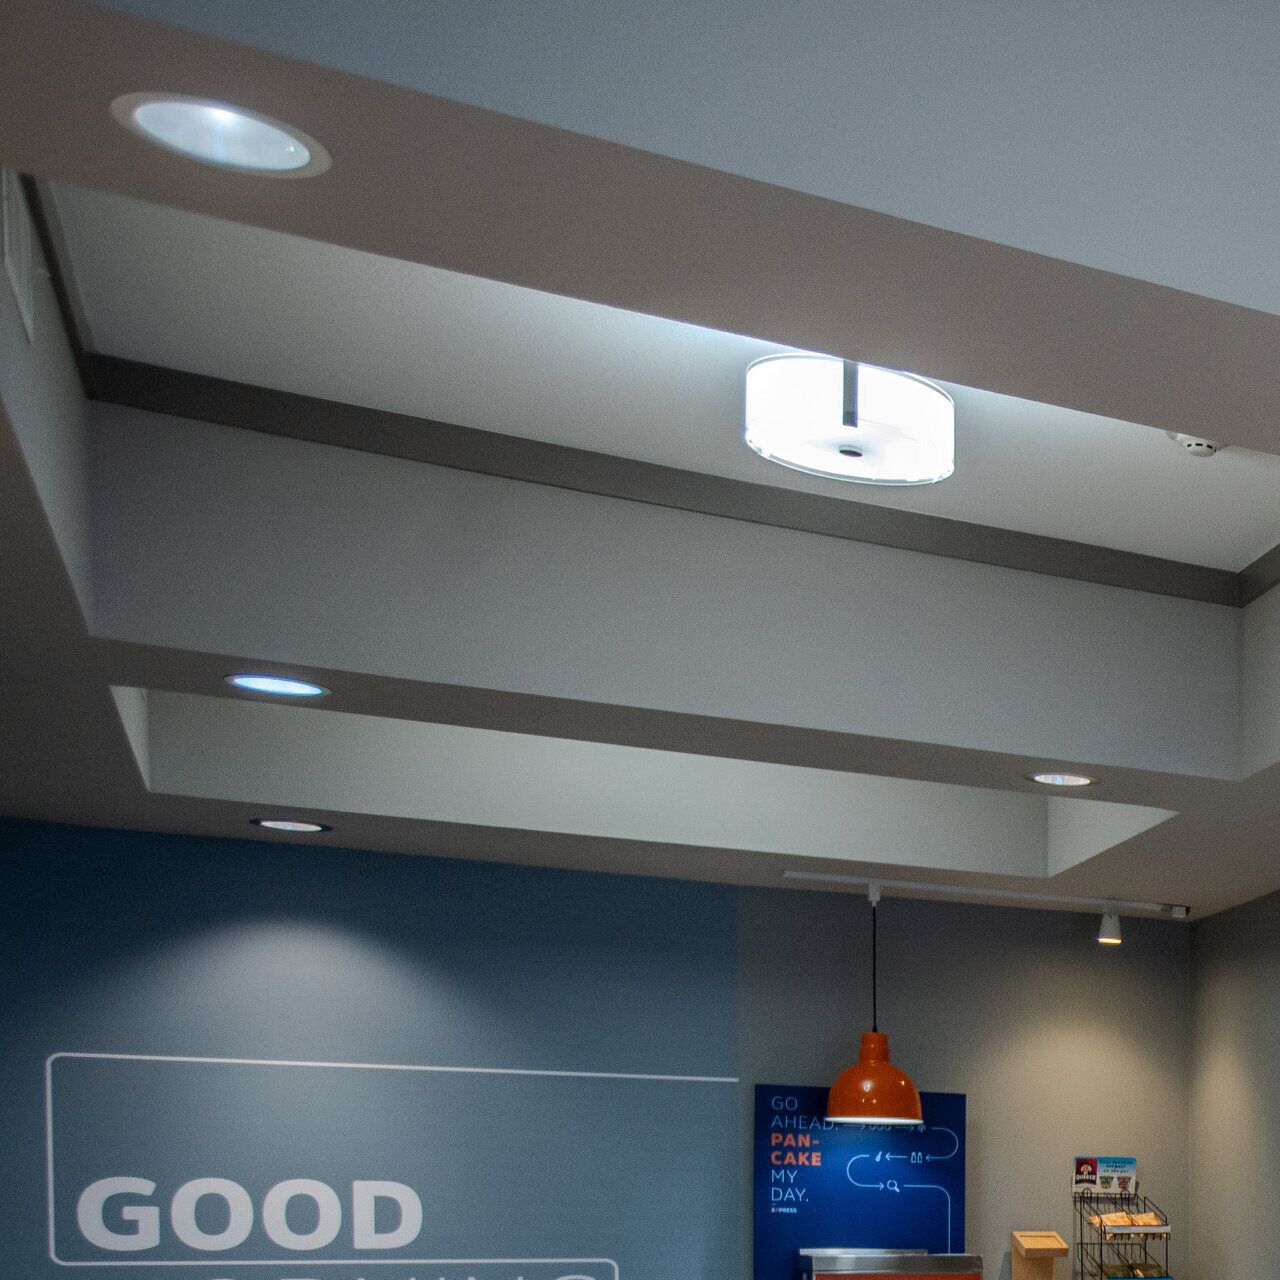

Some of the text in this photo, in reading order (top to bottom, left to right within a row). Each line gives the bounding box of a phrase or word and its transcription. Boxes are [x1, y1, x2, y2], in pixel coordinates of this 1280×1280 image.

[771, 1095, 799, 1111] GO
[770, 1132, 821, 1148] PAN-
[770, 1150, 822, 1167] CAKE
[771, 1169, 798, 1184] MY
[771, 1187, 809, 1203] DAY.
[76, 1176, 424, 1252] GOOD
[771, 1206, 798, 1214] EXPRESS
